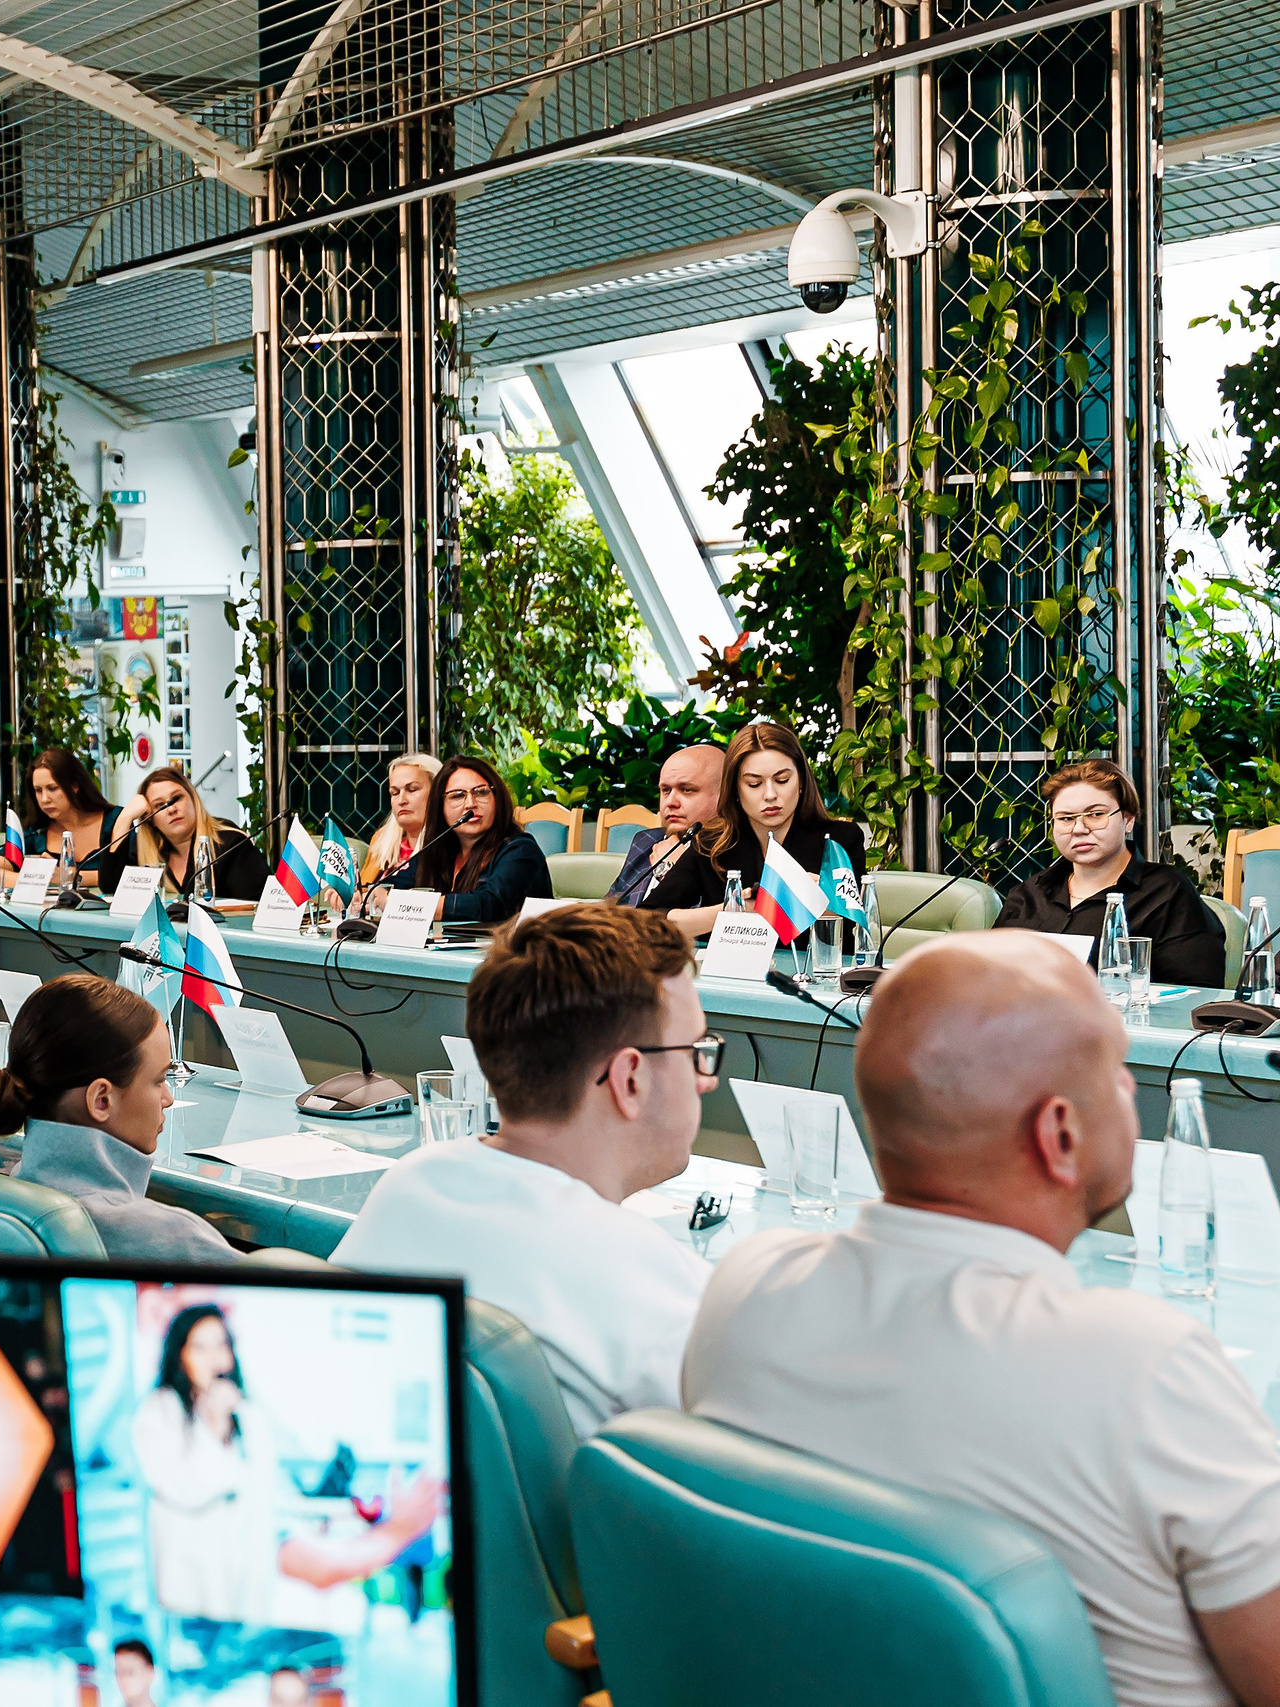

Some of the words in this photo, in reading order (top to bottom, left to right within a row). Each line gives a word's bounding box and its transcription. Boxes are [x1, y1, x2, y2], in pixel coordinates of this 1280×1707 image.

[322, 853, 343, 878] ЛЮДИ
[270, 888, 287, 896] КРАС
[398, 904, 424, 914] ТОМЧУК
[722, 925, 768, 938] МЕЛИКОВА
